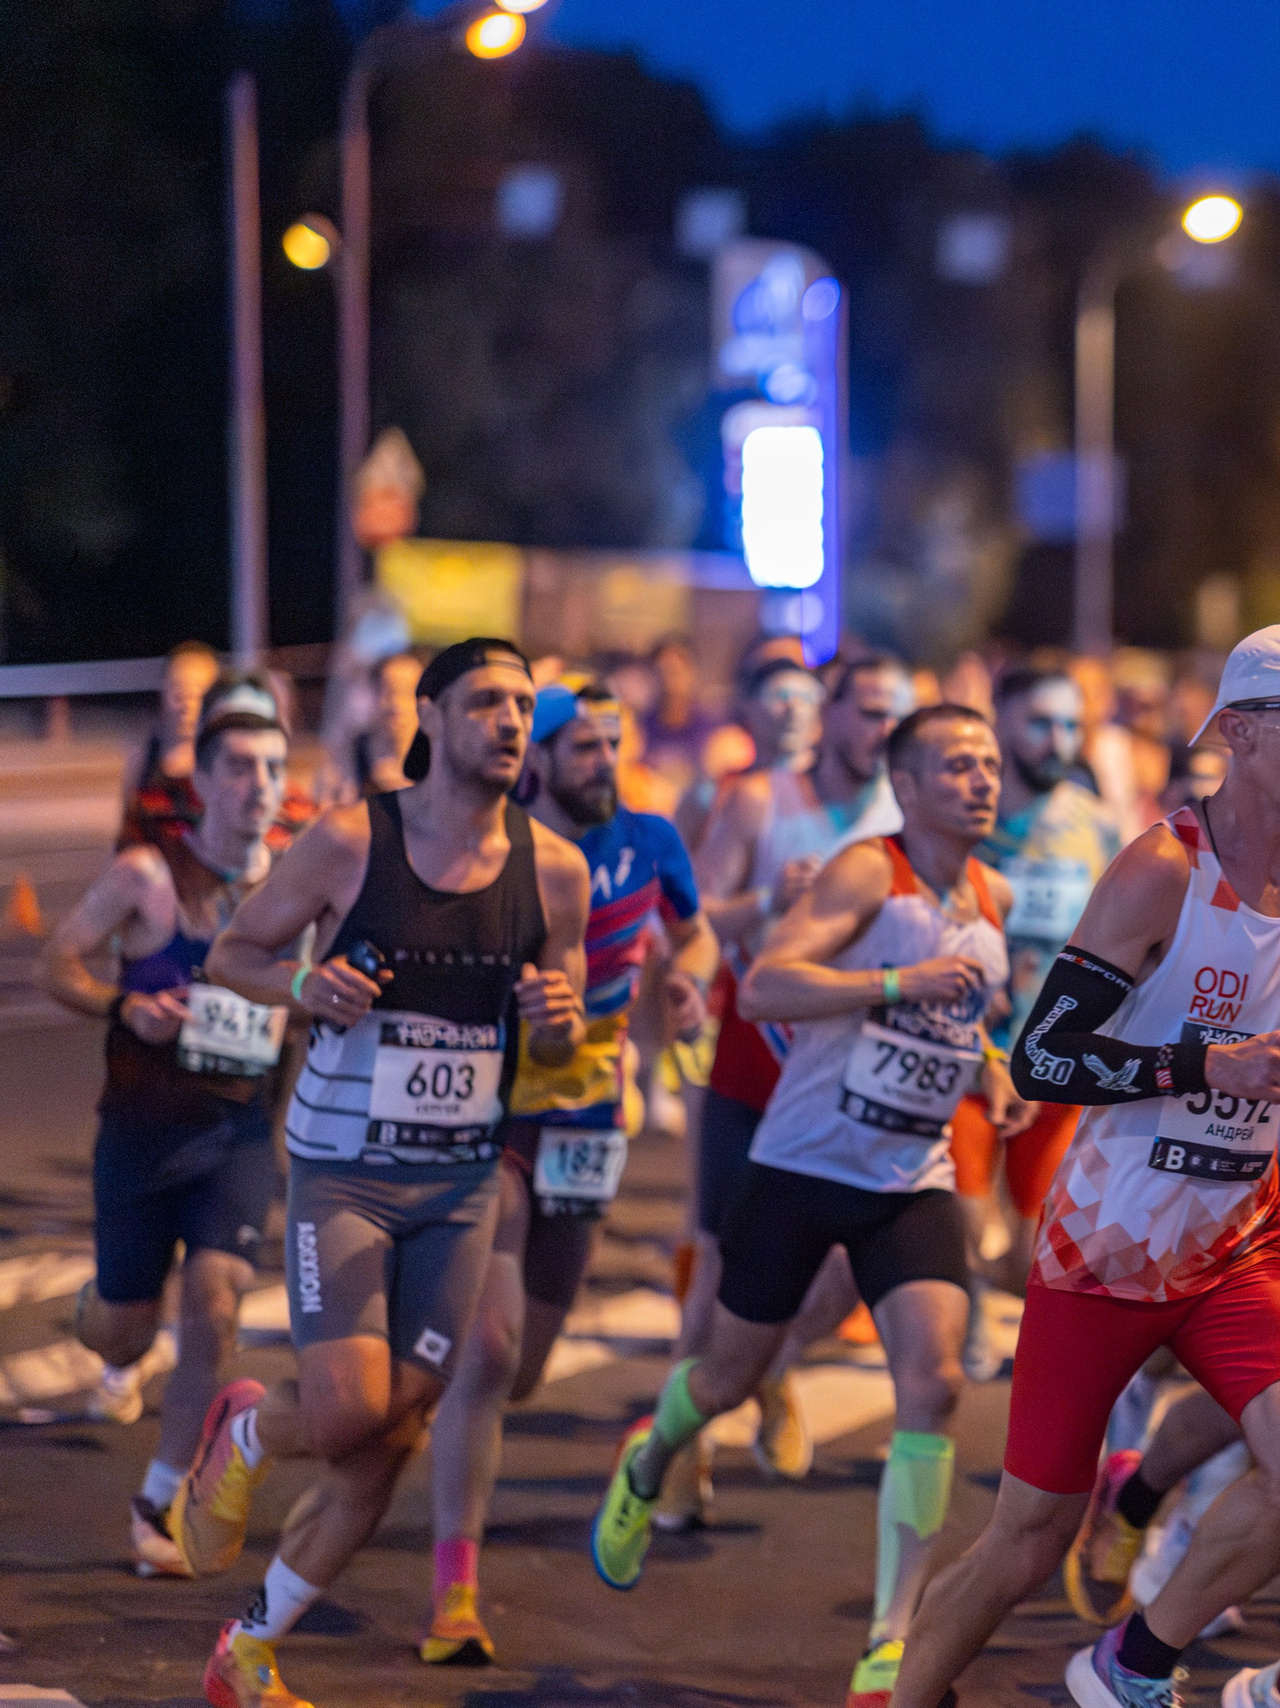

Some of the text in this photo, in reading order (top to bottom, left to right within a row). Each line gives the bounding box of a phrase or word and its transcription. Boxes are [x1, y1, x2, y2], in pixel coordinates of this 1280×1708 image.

[1194, 966, 1249, 1001] ODI
[1189, 994, 1243, 1023] RUN
[405, 1059, 476, 1100] 603
[872, 1040, 961, 1095] 7983
[1205, 1122, 1255, 1142] АНДРЕЙ
